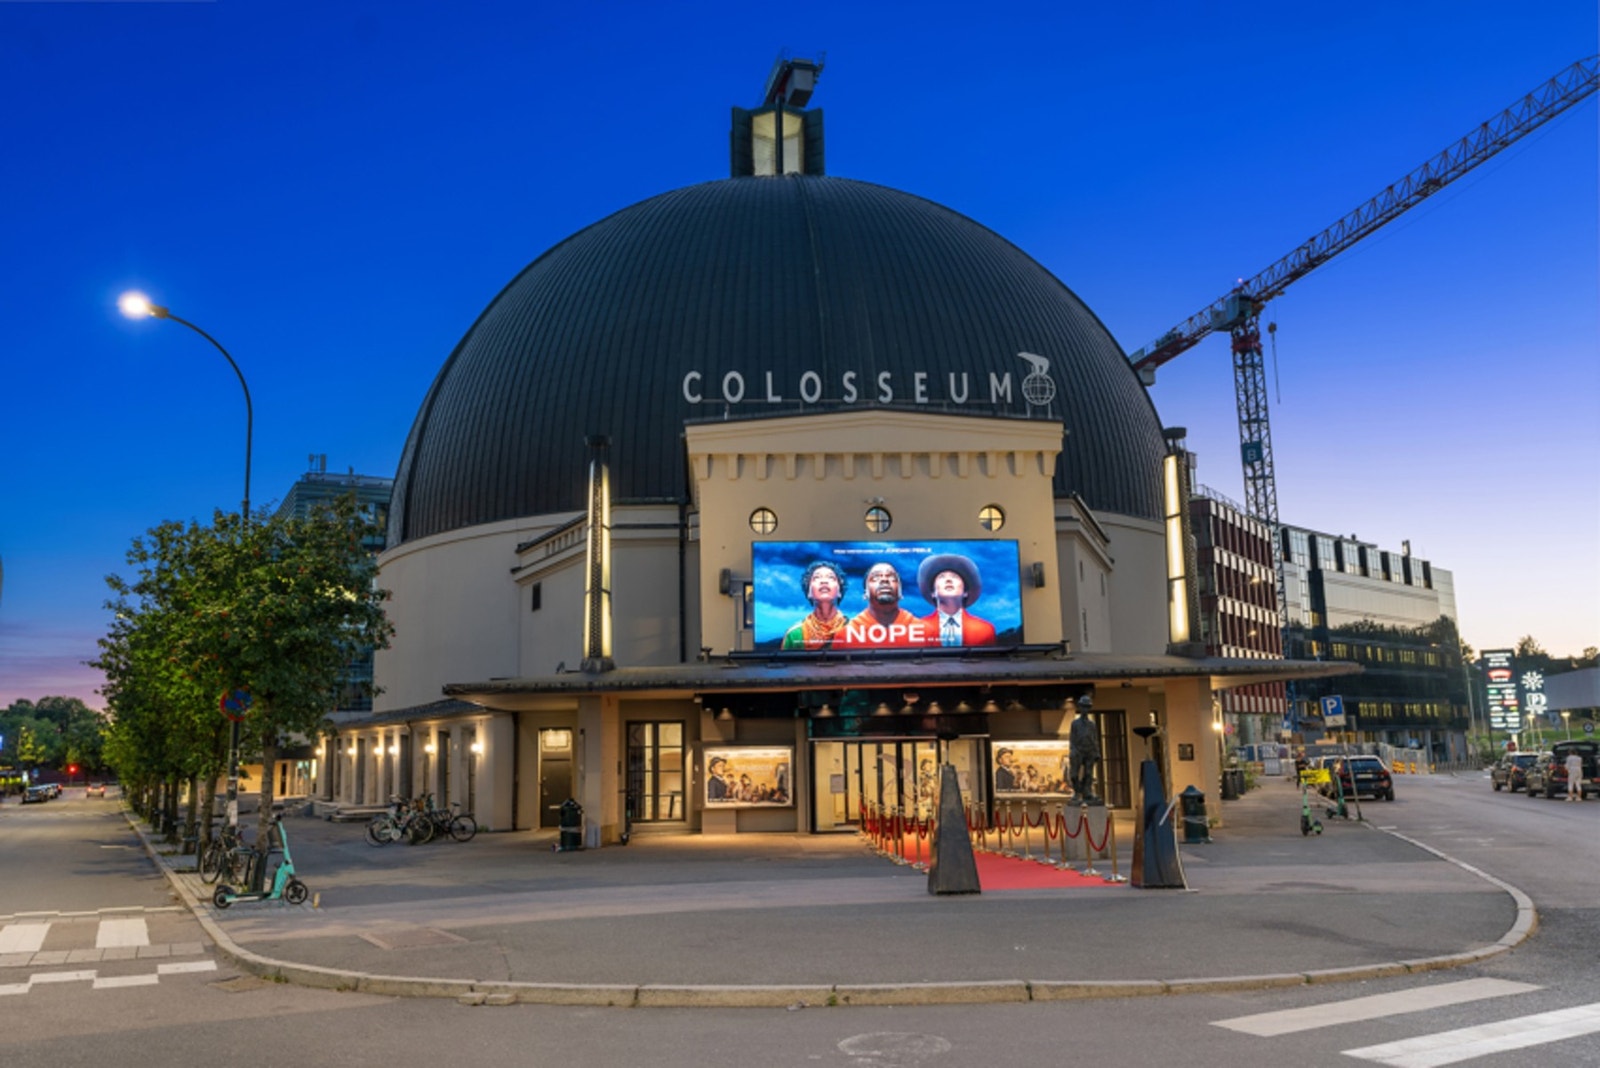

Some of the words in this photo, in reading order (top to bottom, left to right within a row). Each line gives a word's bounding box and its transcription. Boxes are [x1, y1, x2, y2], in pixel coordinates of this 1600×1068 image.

[683, 371, 1012, 403] COLOSSEUM
[846, 624, 925, 643] NOPE
[1326, 699, 1337, 714] P
